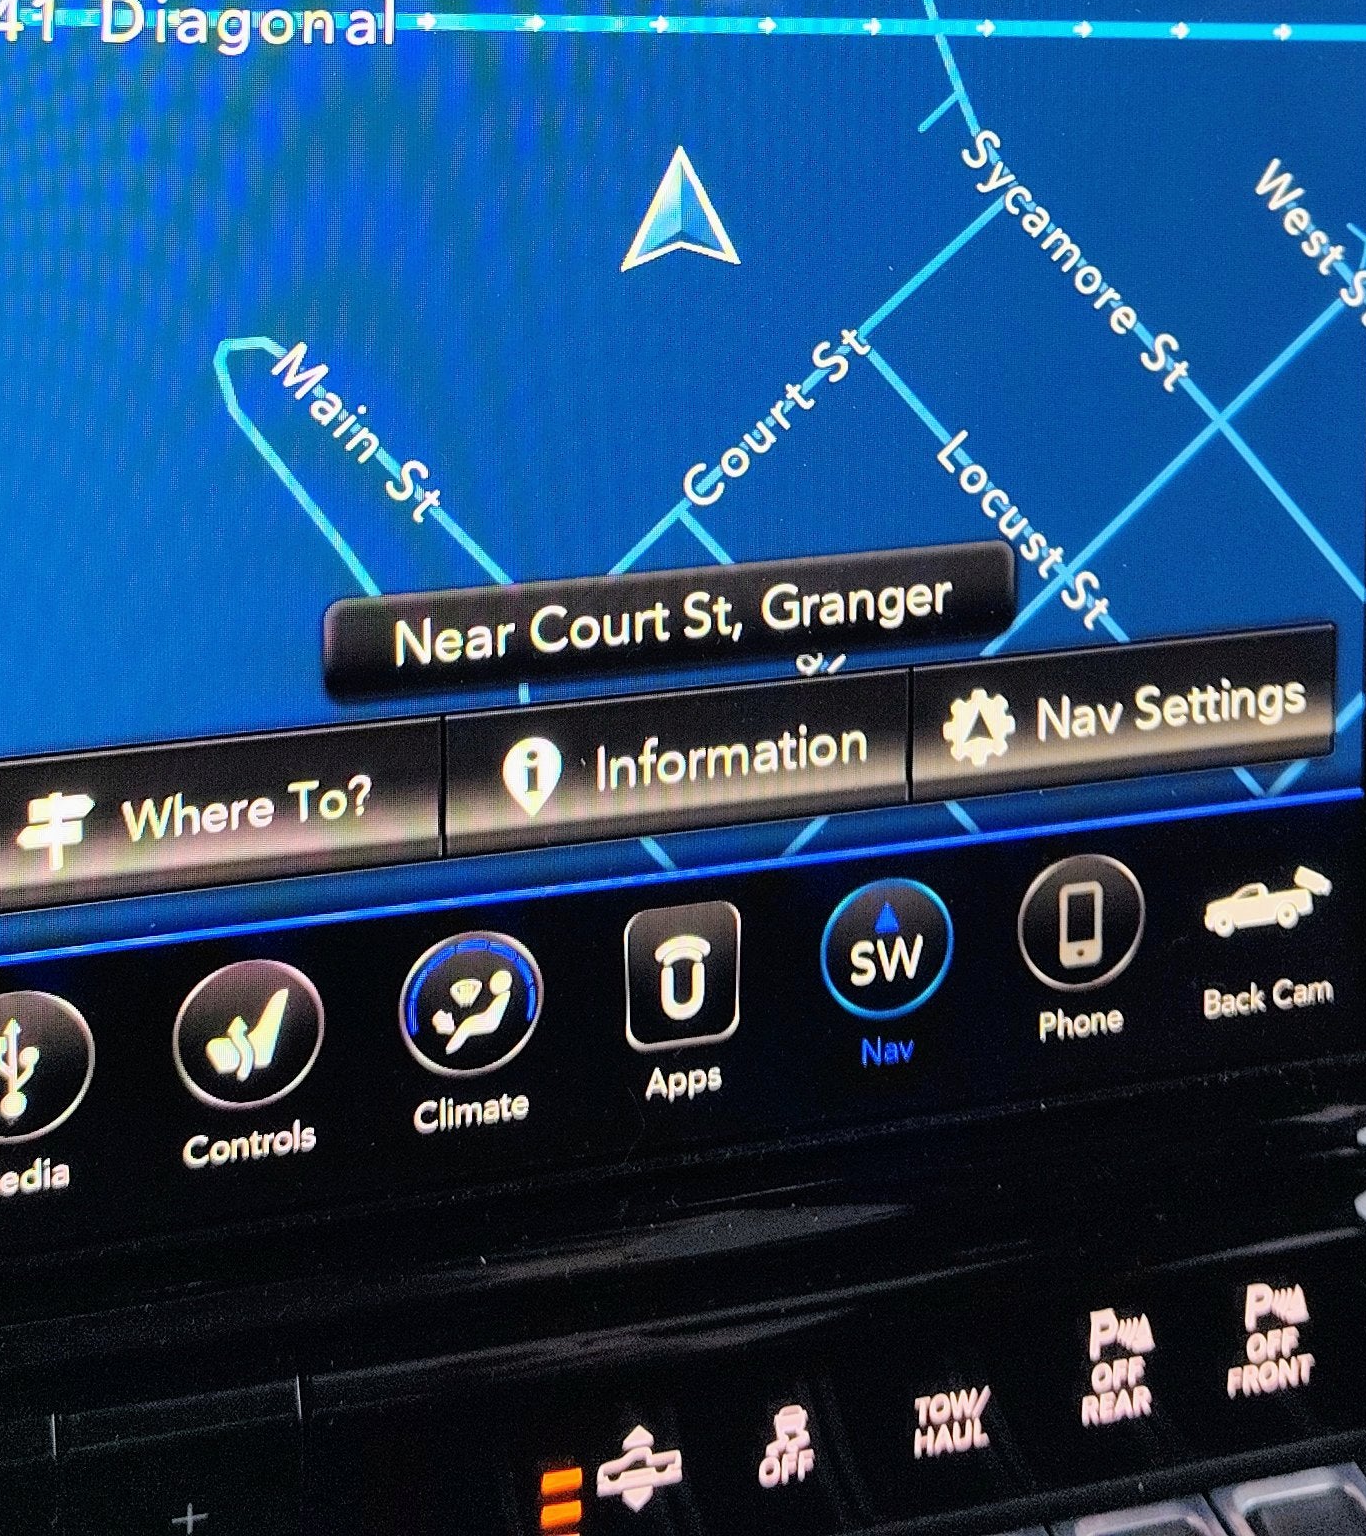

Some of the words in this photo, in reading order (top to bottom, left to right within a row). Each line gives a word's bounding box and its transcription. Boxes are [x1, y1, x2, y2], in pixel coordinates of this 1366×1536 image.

[1254, 157, 1344, 275] West
[961, 129, 1136, 335] Sycamore
[1140, 333, 1188, 392] St
[271, 341, 380, 465] Main
[385, 459, 441, 522] St
[683, 381, 814, 506] Court
[812, 327, 871, 383] St
[937, 429, 1064, 579] Locust
[1060, 570, 1110, 631] St
[395, 618, 515, 667] Near
[530, 601, 670, 654] Court
[684, 590, 743, 642] St,
[762, 577, 953, 632] Granger
[1036, 695, 1123, 742] Nav
[1135, 678, 1306, 733] Settings
[596, 723, 868, 792] Information
[123, 792, 274, 843] Where
[287, 774, 373, 824] To?
[850, 935, 923, 986] SW
[1204, 984, 1265, 1020] Back
[1272, 976, 1333, 1010] Cam
[1039, 1006, 1124, 1042] Phone
[861, 1038, 914, 1066] Nav
[645, 1066, 721, 1103] Apps
[413, 1090, 529, 1135] Climate
[183, 1121, 316, 1169] Controls
[1246, 1326, 1300, 1364] OFF
[1091, 1356, 1146, 1394] OFF
[1227, 1353, 1316, 1399] FRONT
[915, 1385, 992, 1427] TOW/
[1082, 1384, 1152, 1427] REAR
[914, 1417, 990, 1459] HAUL
[759, 1450, 814, 1490] OFF
